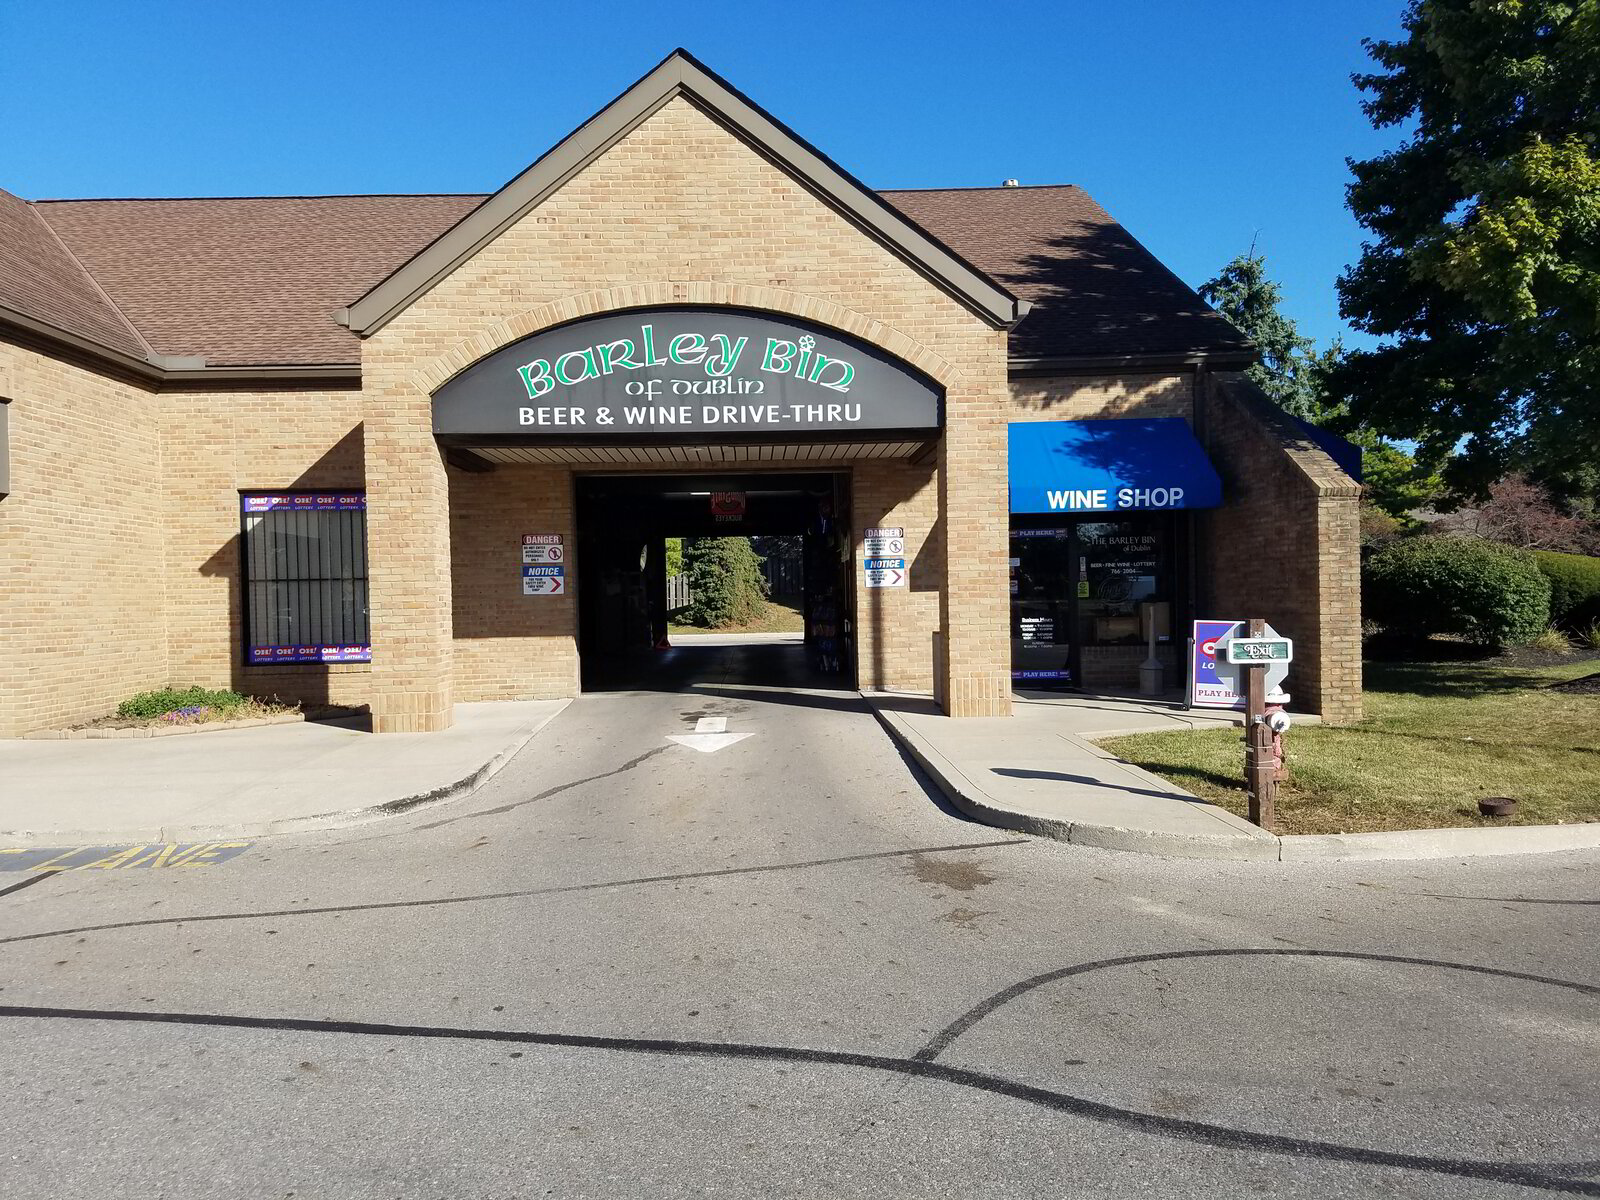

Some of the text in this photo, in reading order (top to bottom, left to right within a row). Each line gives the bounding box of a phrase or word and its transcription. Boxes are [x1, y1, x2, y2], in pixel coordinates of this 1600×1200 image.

[625, 379, 662, 401] of
[519, 403, 862, 425] BEER & WINE DRIVE-THRU
[1047, 487, 1184, 509] WINE SHOP
[868, 529, 900, 537] DANGER
[526, 536, 559, 544] DANGER
[1109, 536, 1139, 544] BARLEY
[1141, 536, 1156, 544] BIN
[870, 560, 900, 569] NOTICE
[528, 567, 560, 576] NOTICE
[1243, 643, 1277, 659] Exit
[1198, 689, 1222, 697] PLAY
